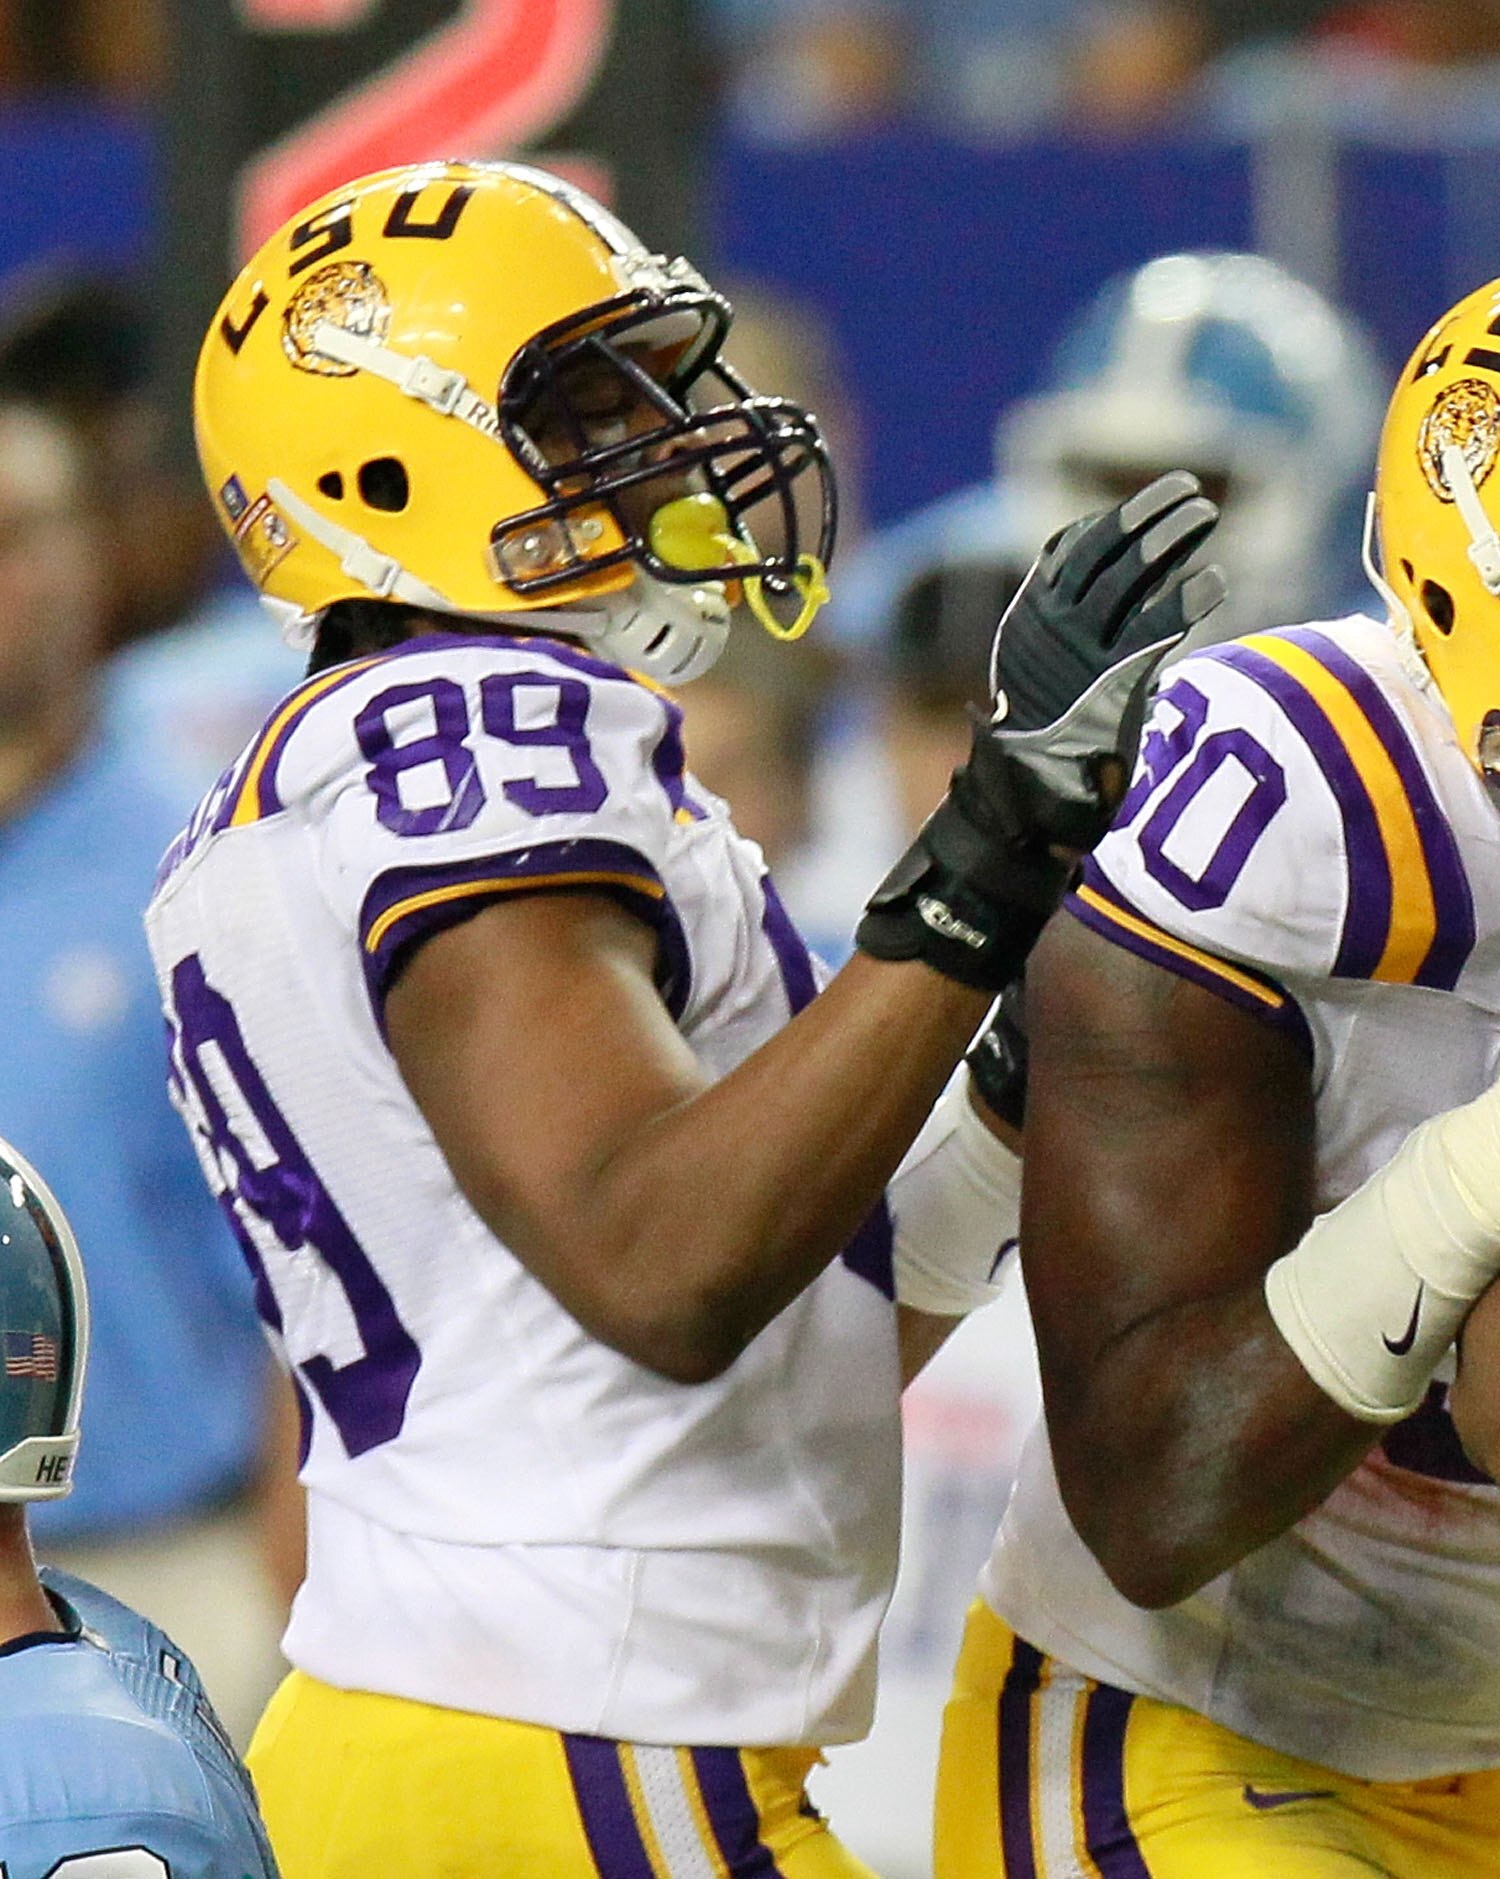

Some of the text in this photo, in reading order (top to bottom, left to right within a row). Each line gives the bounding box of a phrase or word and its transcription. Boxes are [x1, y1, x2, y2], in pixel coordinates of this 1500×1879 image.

[220, 185, 476, 356] LSU
[354, 671, 610, 837] 89
[166, 951, 423, 1475] 9
